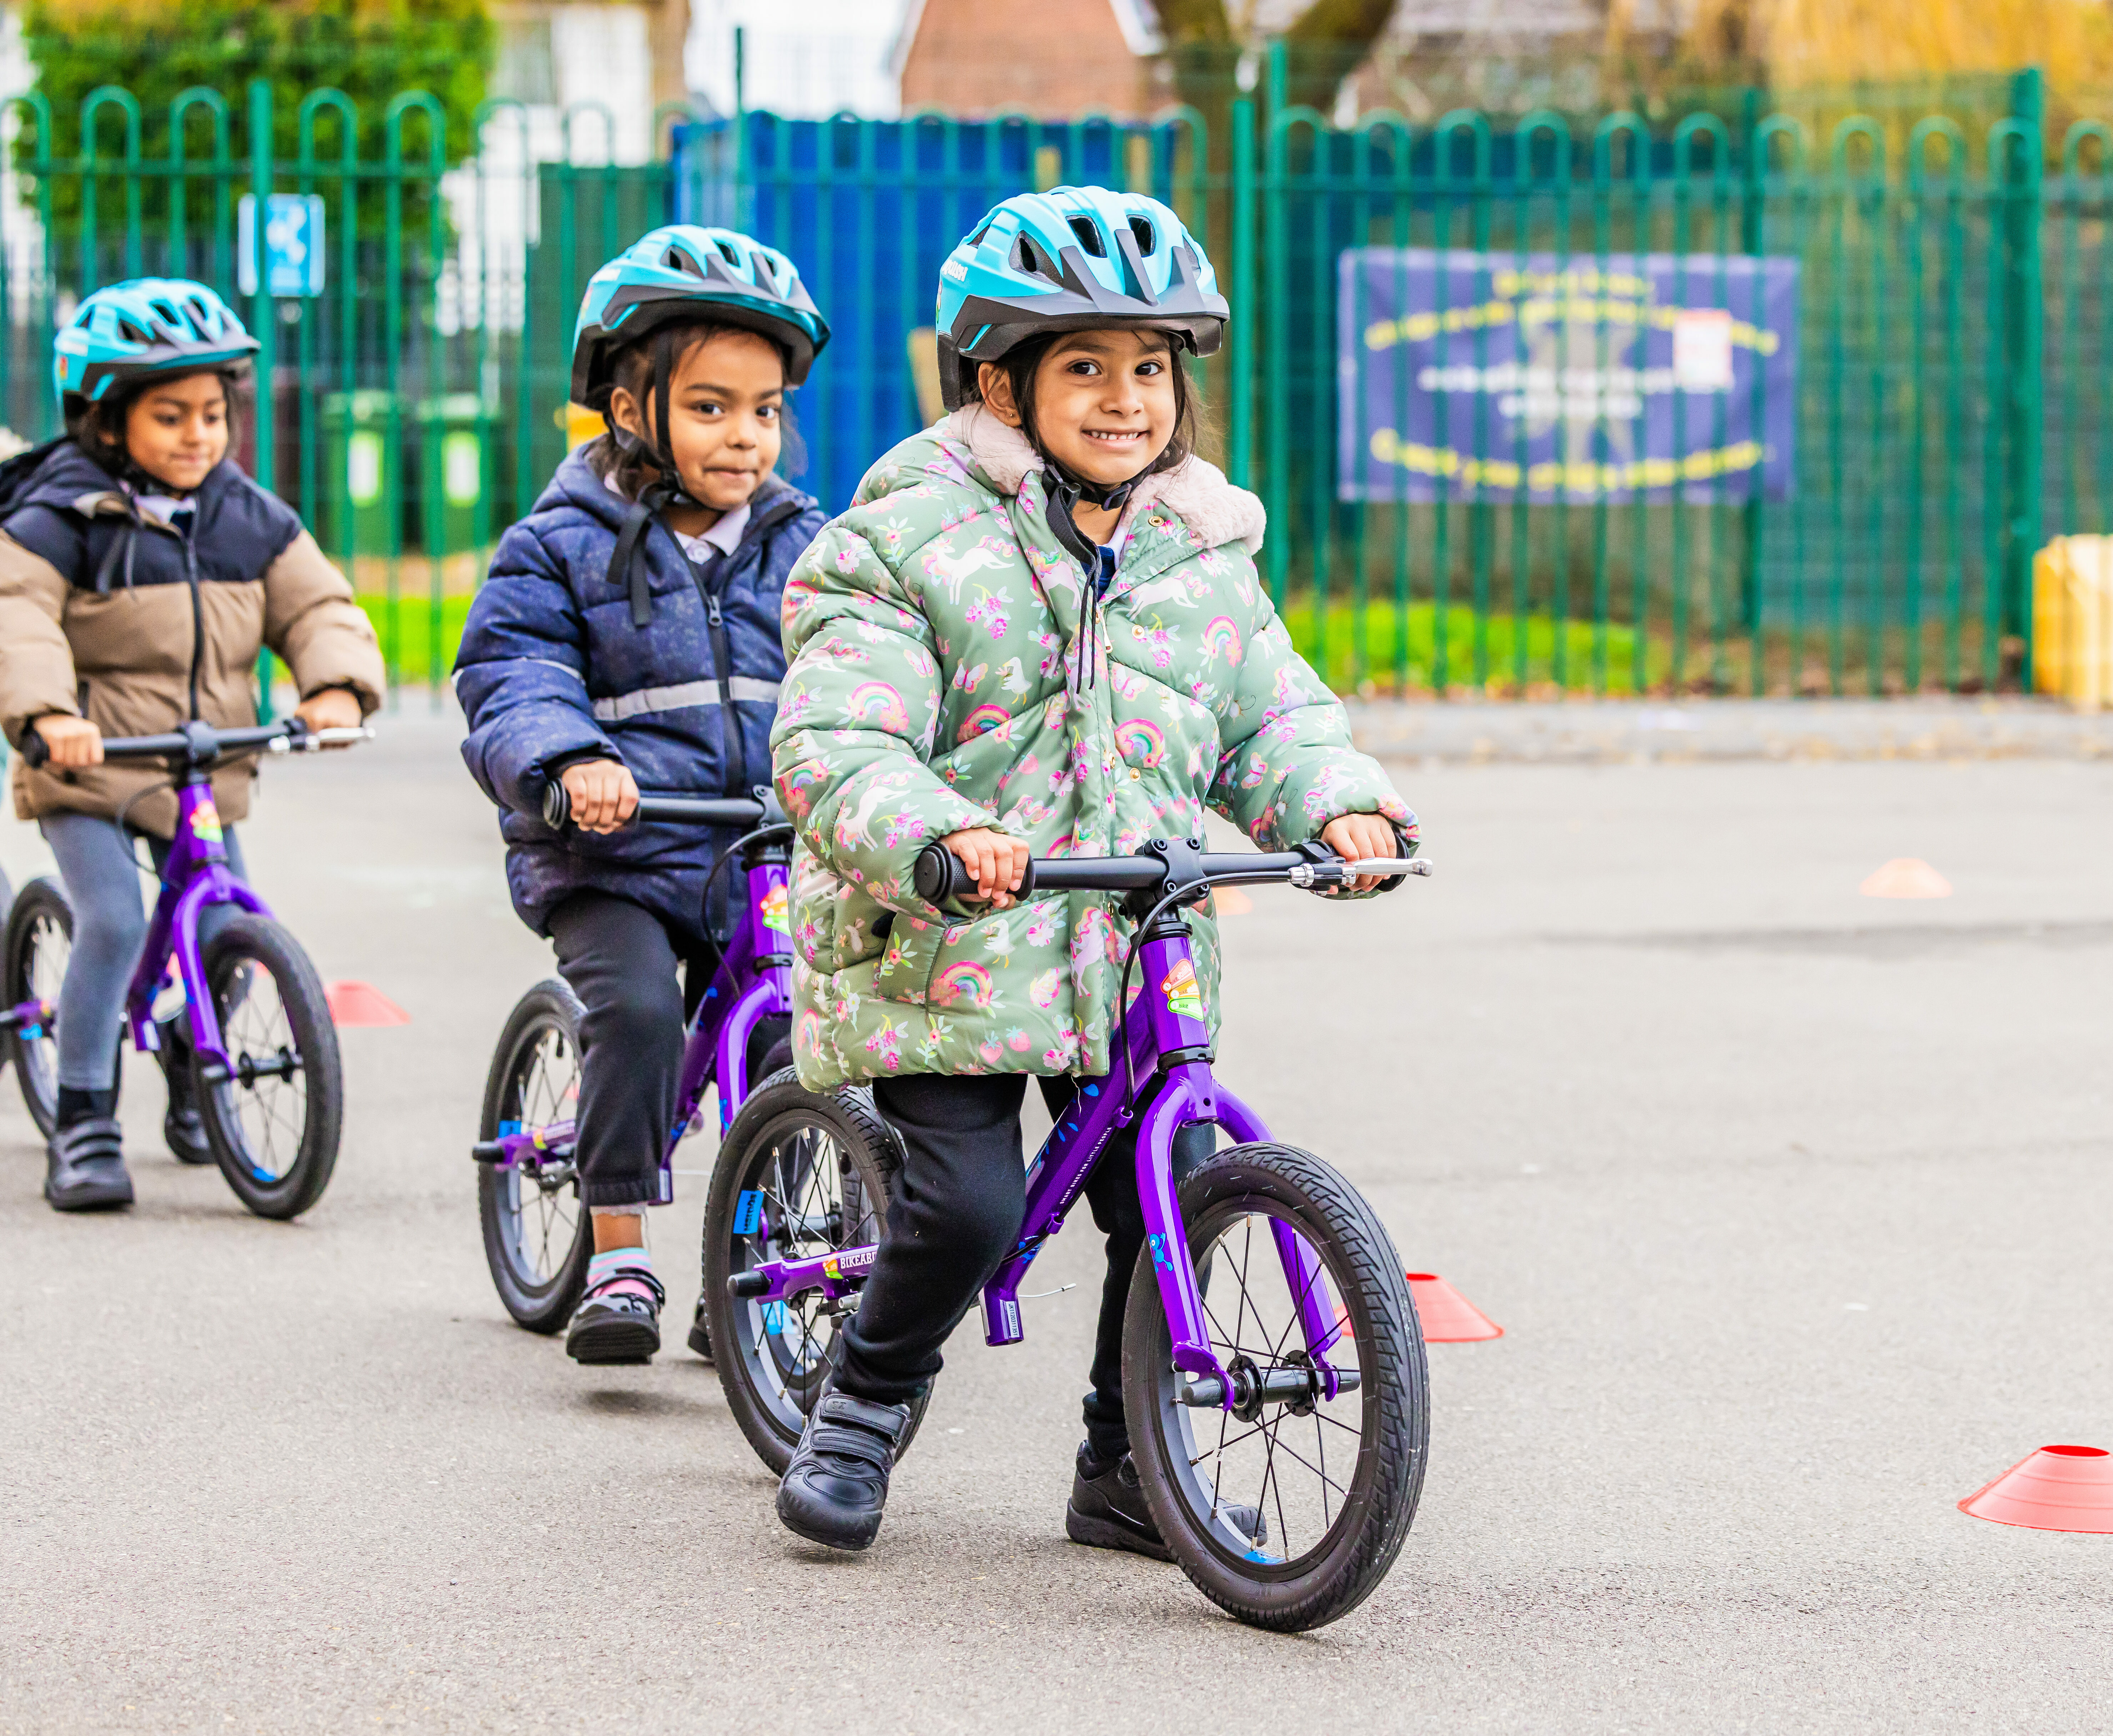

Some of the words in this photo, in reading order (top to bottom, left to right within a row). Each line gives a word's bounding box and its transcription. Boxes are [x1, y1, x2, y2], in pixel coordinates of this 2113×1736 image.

[1060, 1189, 1072, 1204] SMART
[1070, 1174, 1082, 1187] BIKES
[1080, 1163, 1088, 1172] FOR
[1087, 1146, 1100, 1162] LITTLE
[1097, 1127, 1112, 1144] PEOPLE
[840, 1251, 877, 1269] BIKEABI
[1008, 1304, 1018, 1335] JK1120311351
